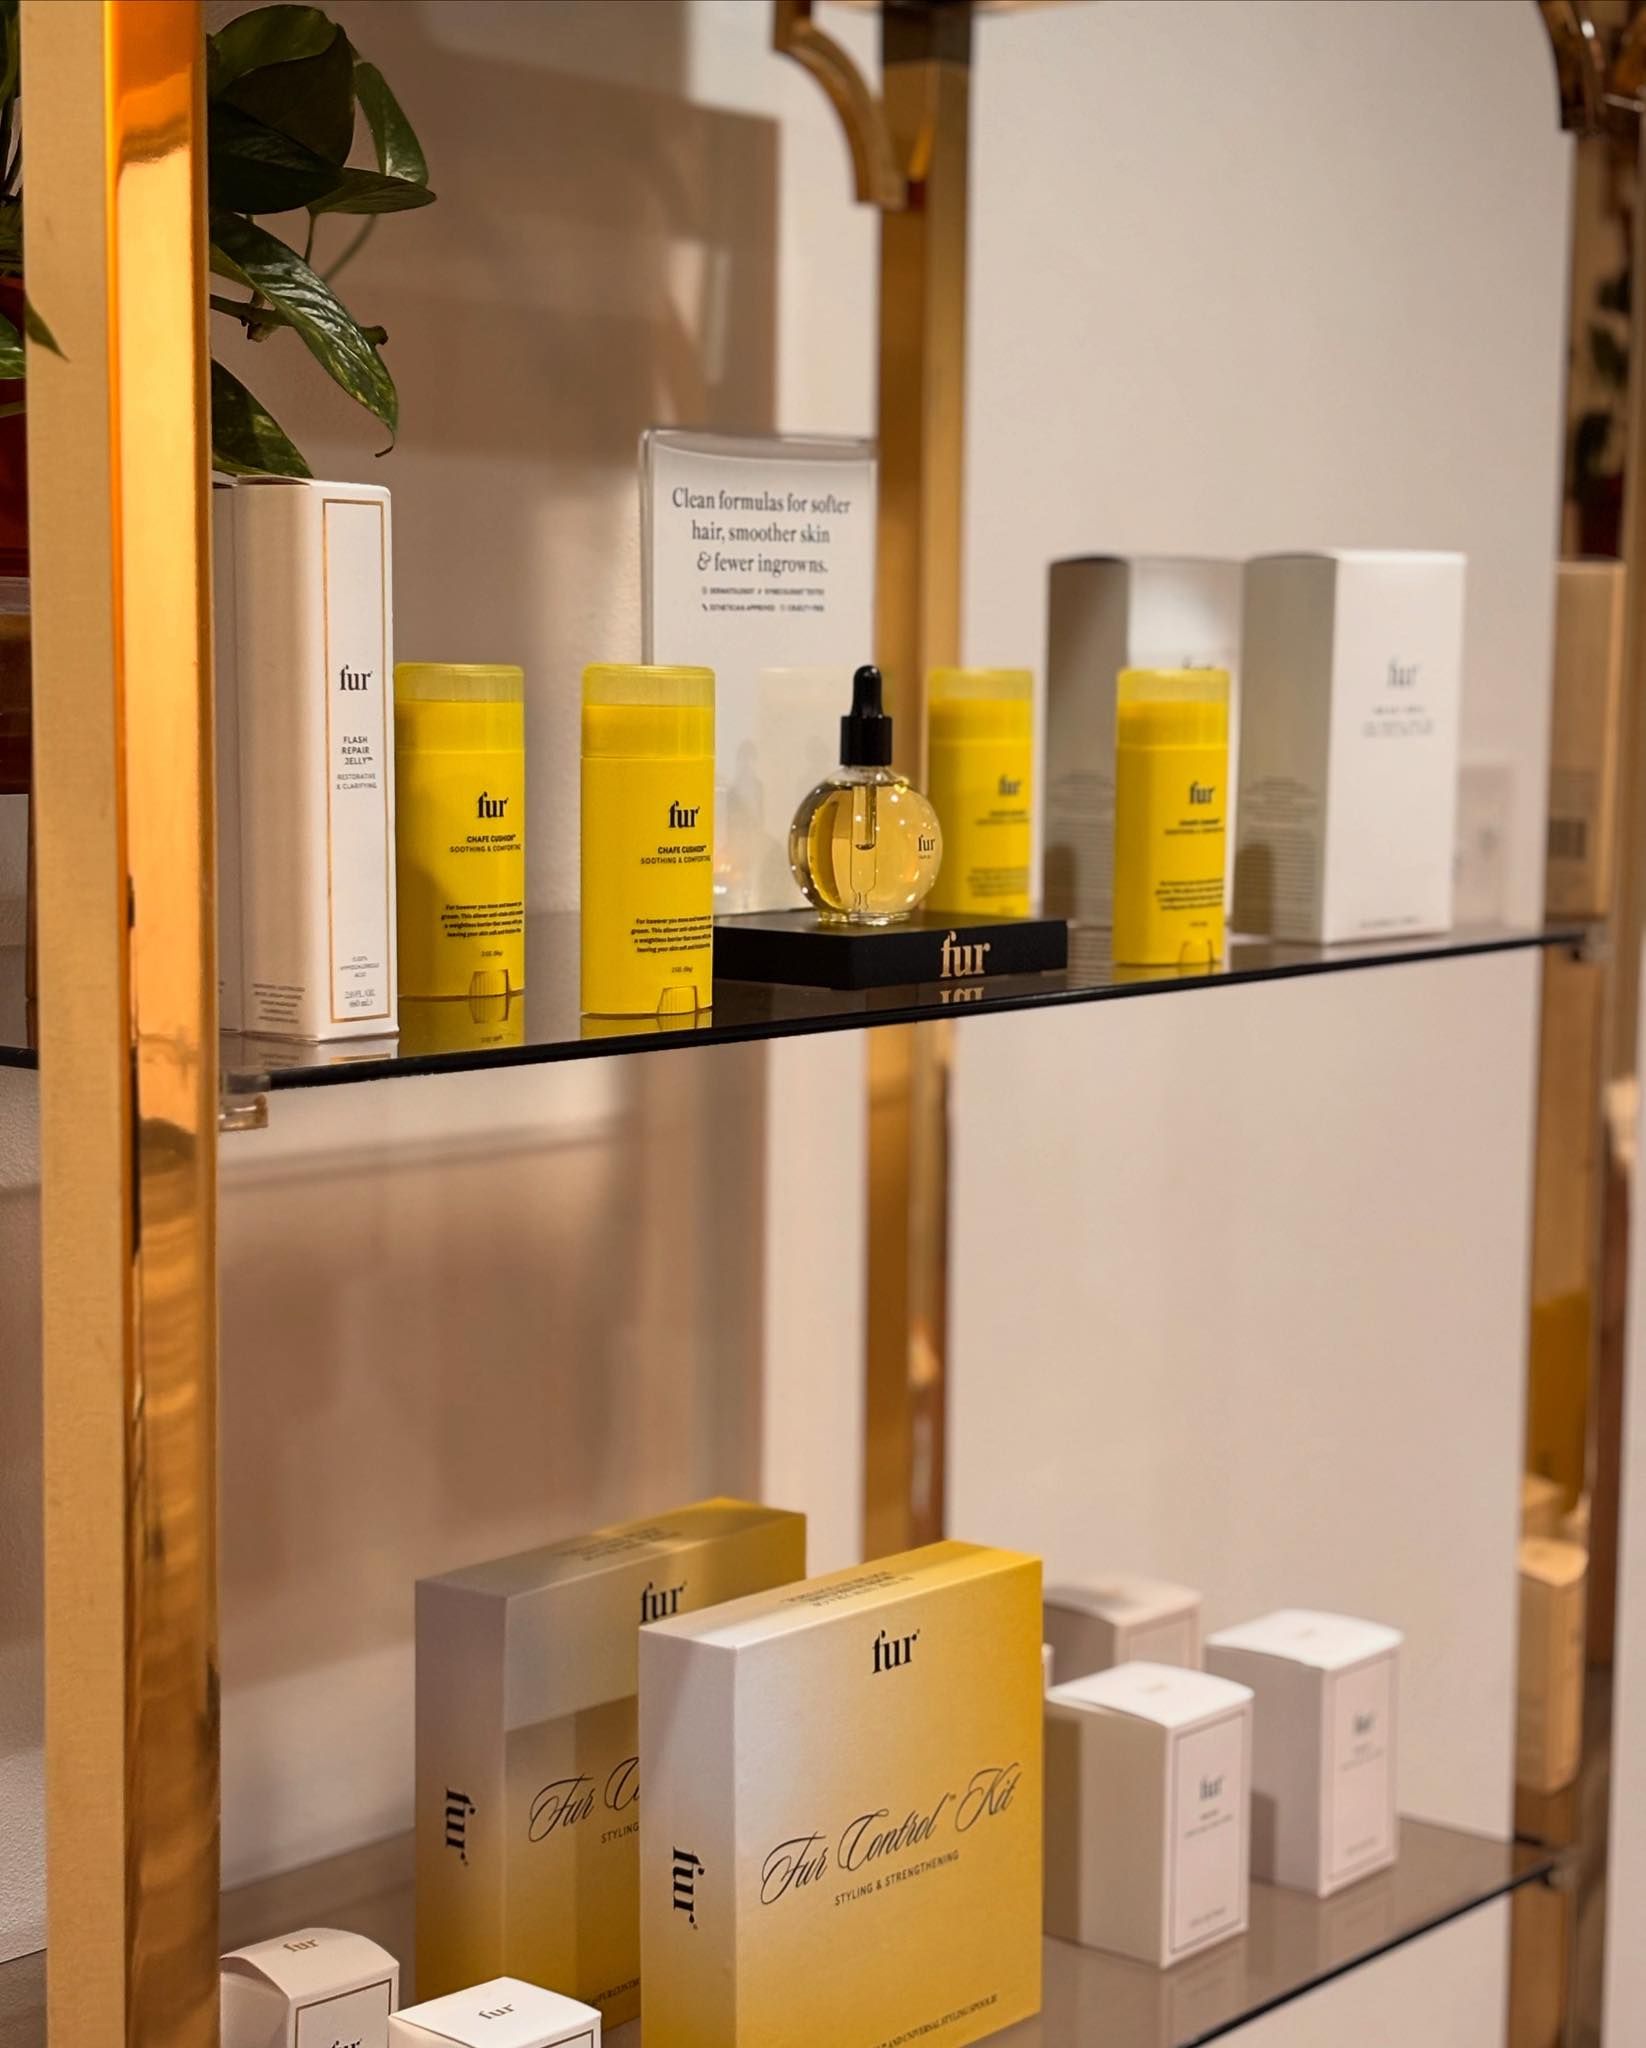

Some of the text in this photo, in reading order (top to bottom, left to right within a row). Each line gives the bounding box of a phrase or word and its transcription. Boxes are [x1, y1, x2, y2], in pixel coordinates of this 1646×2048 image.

[672, 486, 850, 514] Clean formulas for softer
[691, 519, 830, 544] hair, smoother skin
[697, 551, 828, 577] & fewer ingrowns.
[340, 664, 373, 691] fur
[341, 746, 370, 755] REPAIR
[343, 736, 368, 744] FLASH
[477, 791, 508, 818] fur
[1189, 780, 1215, 806] fur
[668, 800, 700, 829] fur
[449, 845, 486, 853] SOOTHING
[467, 835, 489, 843] CHAFE
[658, 846, 681, 854] CHAFE
[918, 834, 936, 852] fur
[640, 857, 677, 865] SOOTHING
[940, 930, 991, 978] fur
[639, 1582, 685, 1624] fur
[871, 1629, 920, 1674] fur
[528, 1772, 595, 1842] Fur
[445, 1787, 476, 1862] fur
[600, 1822, 640, 1845] STYLING
[760, 1831, 829, 1905] Fur
[954, 1762, 1022, 1833] Kit
[672, 1845, 705, 1925] fur
[834, 1849, 960, 1907] STYLING & STRENGTHENING
[283, 1936, 320, 1953] fur
[478, 2001, 516, 2021] fur
